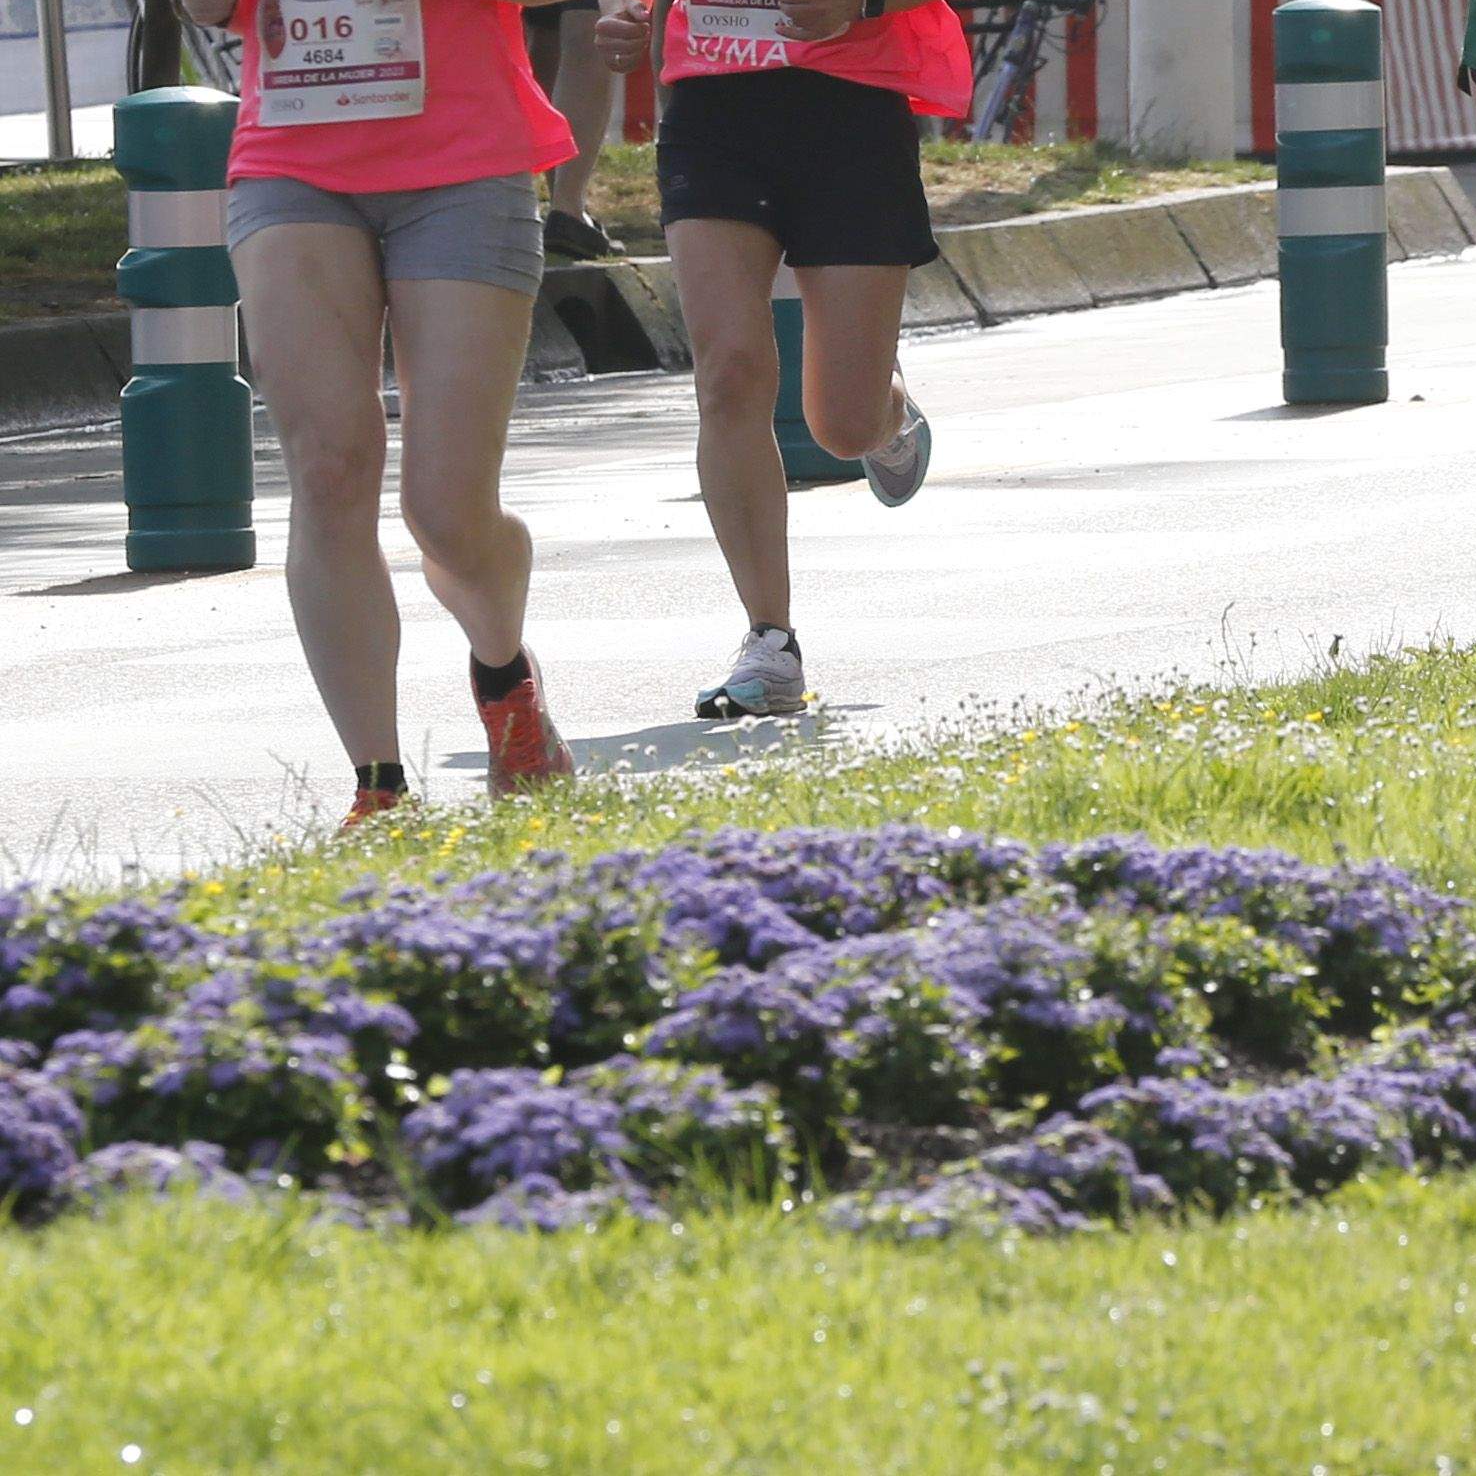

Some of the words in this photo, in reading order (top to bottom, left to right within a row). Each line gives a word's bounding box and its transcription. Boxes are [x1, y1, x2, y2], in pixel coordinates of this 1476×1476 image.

[290, 15, 354, 41] 016
[702, 14, 749, 27] OYSHO
[302, 49, 345, 65] 4684
[303, 74, 317, 84] DE
[320, 72, 336, 82] LA
[352, 91, 411, 106] Santander
